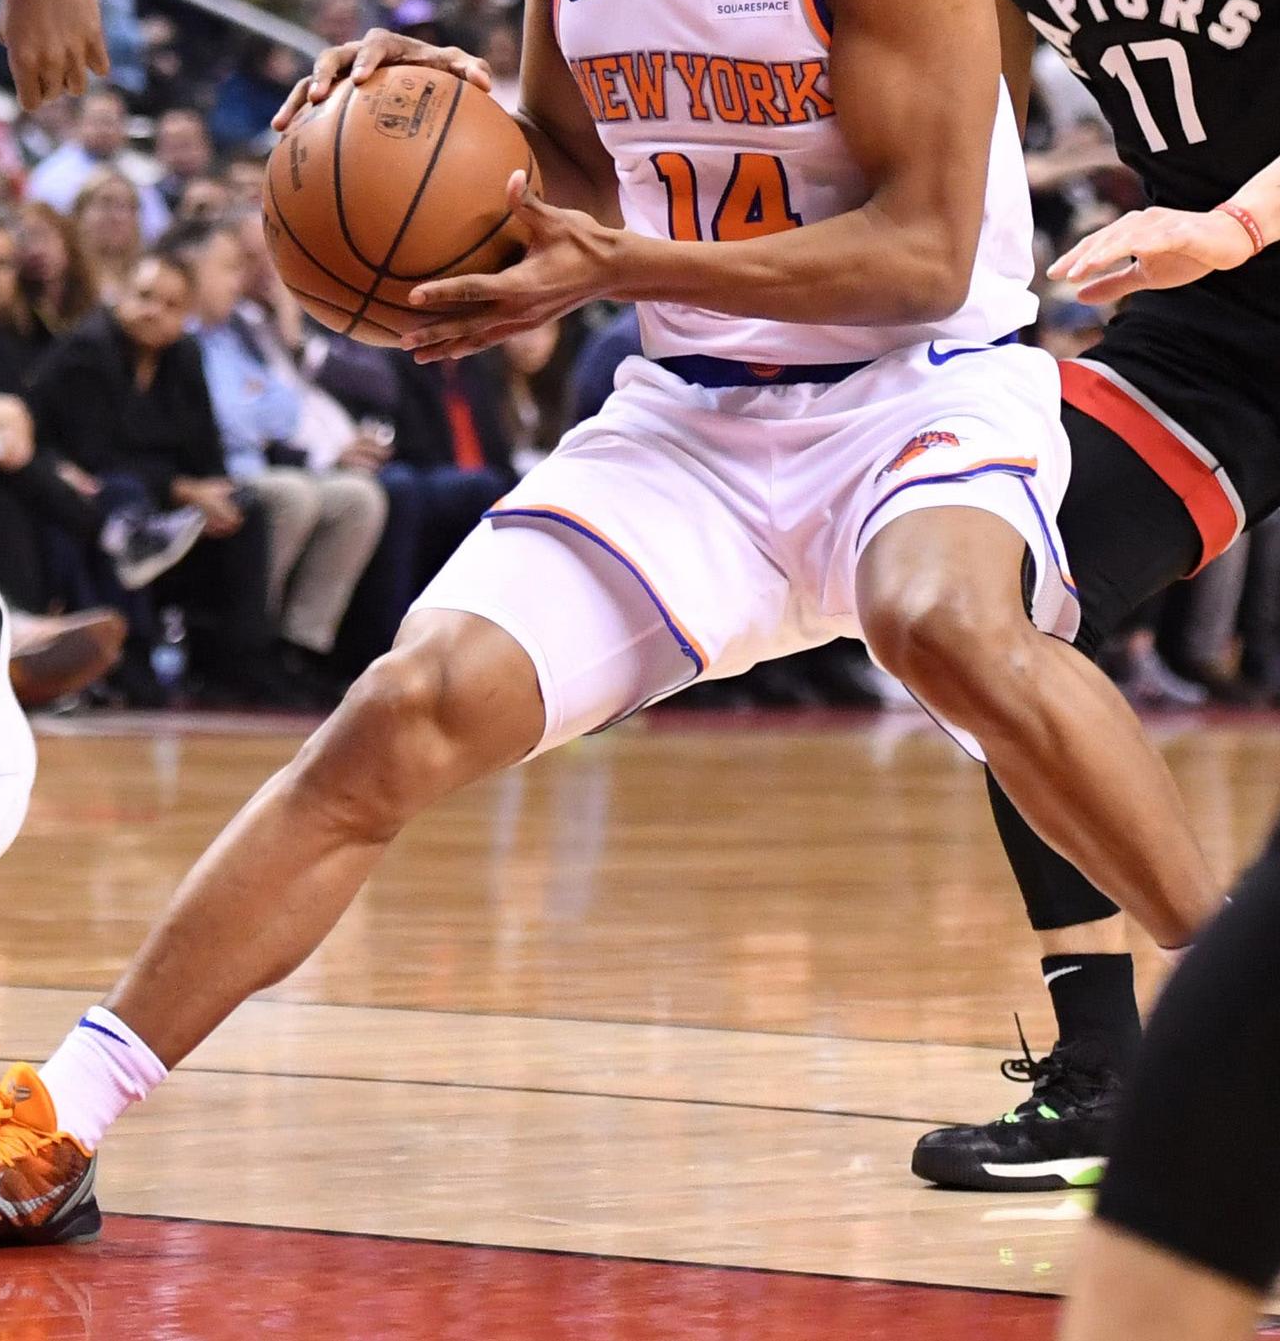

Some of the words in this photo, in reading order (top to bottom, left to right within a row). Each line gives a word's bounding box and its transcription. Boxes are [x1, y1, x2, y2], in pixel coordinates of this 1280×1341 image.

[717, 1, 789, 14] SQUARESPACE
[573, 51, 667, 121] NEW
[670, 51, 837, 126] YORK
[1100, 38, 1208, 153] 17
[651, 152, 804, 242] 14
